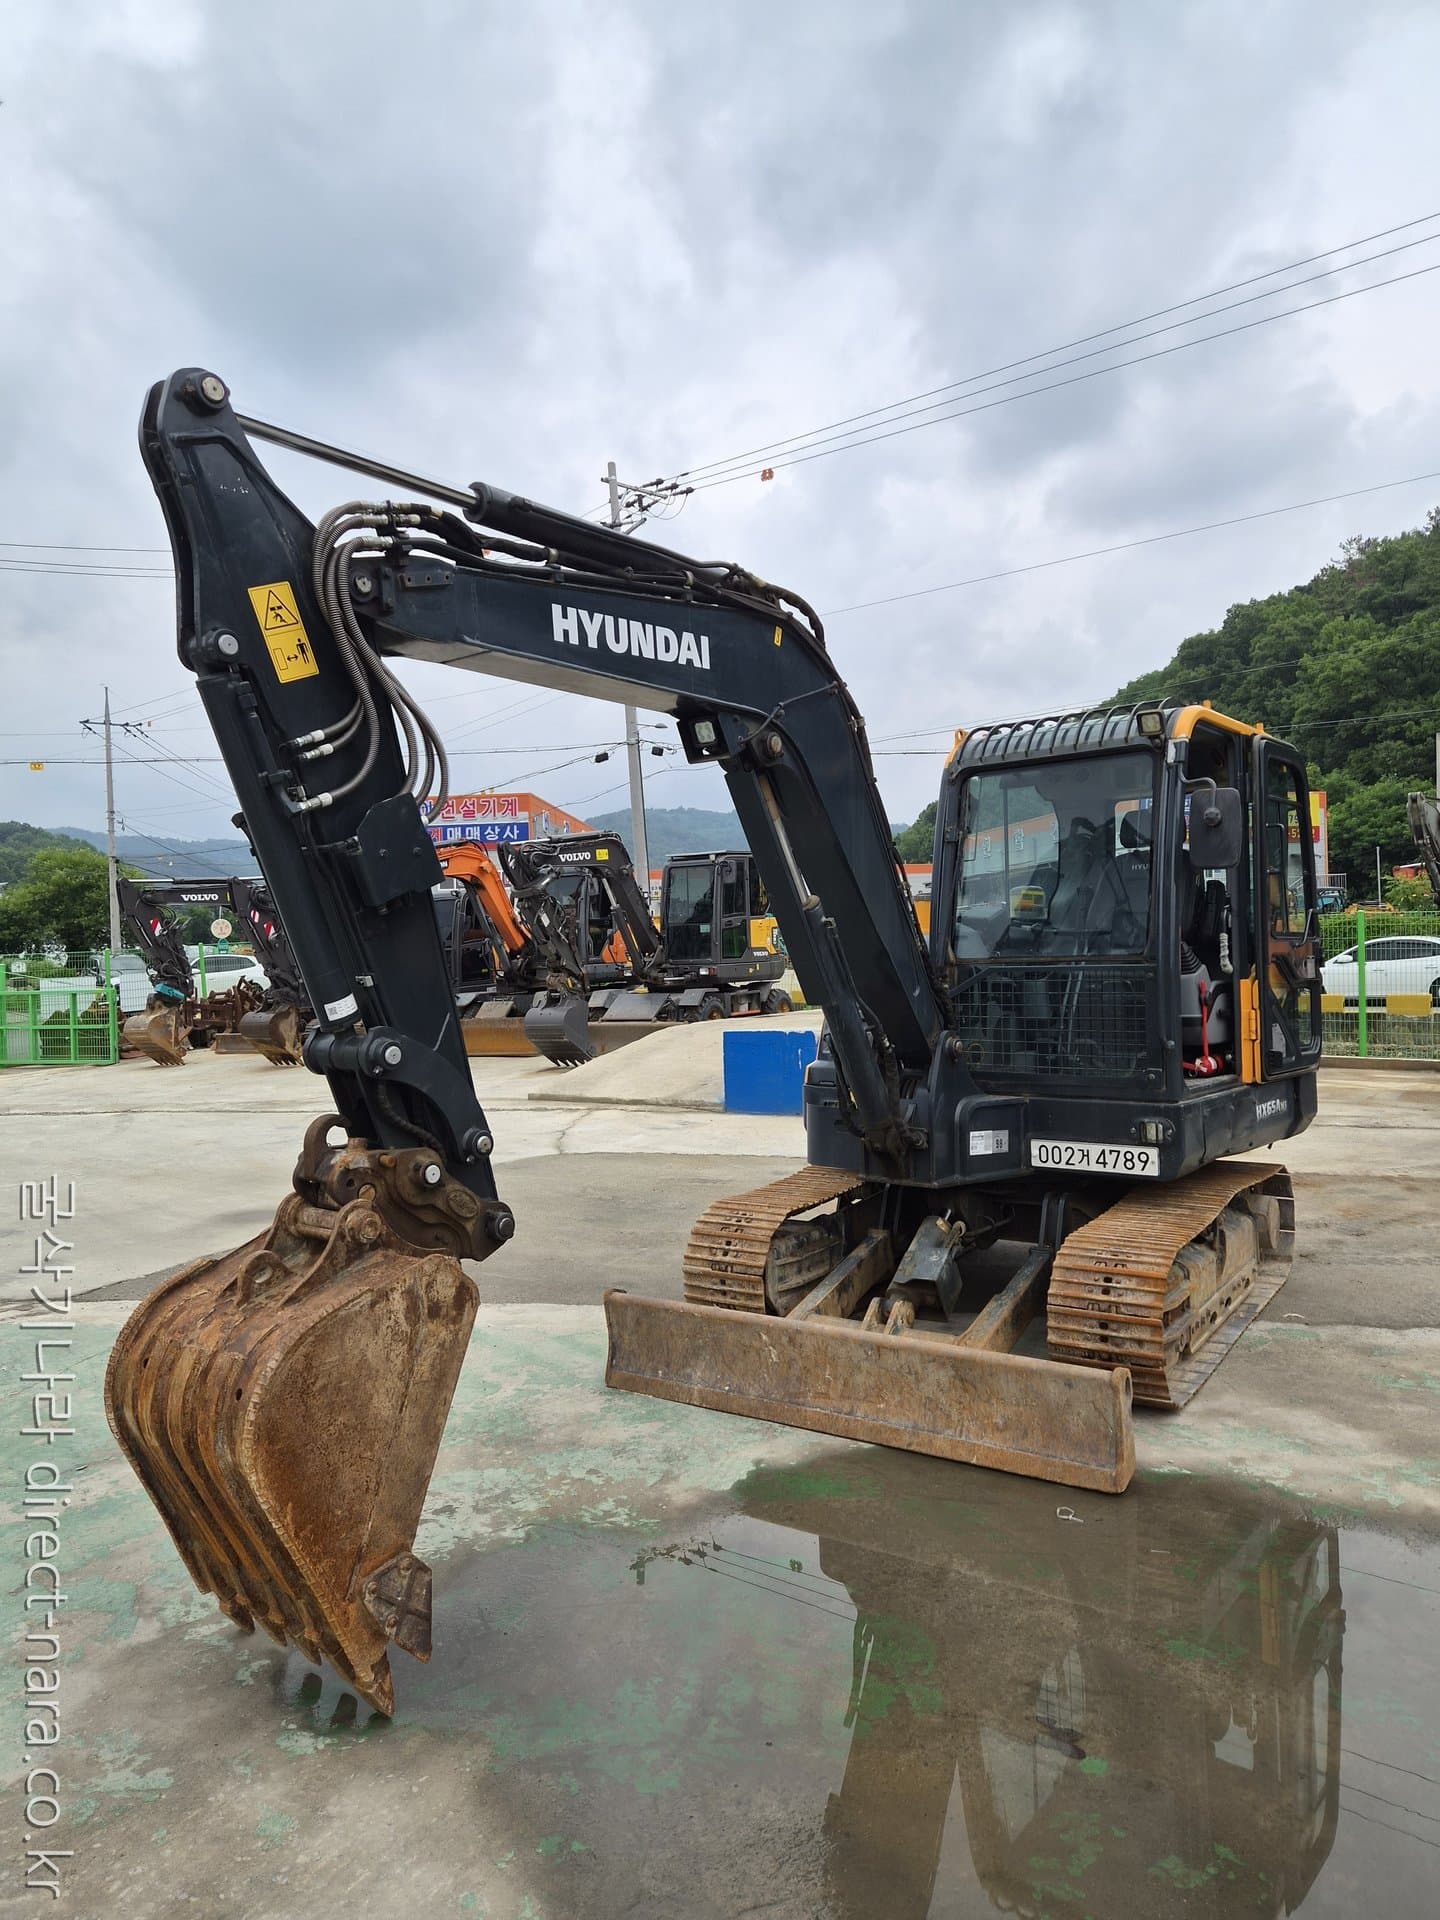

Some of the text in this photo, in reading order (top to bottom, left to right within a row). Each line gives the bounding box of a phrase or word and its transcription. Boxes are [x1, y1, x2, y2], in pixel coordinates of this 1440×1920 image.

[551, 603, 712, 670] HYUNDAI
[558, 851, 591, 862] VOLVO
[180, 893, 219, 901] VOLVO
[1038, 1144, 1150, 1172] 002거 4789
